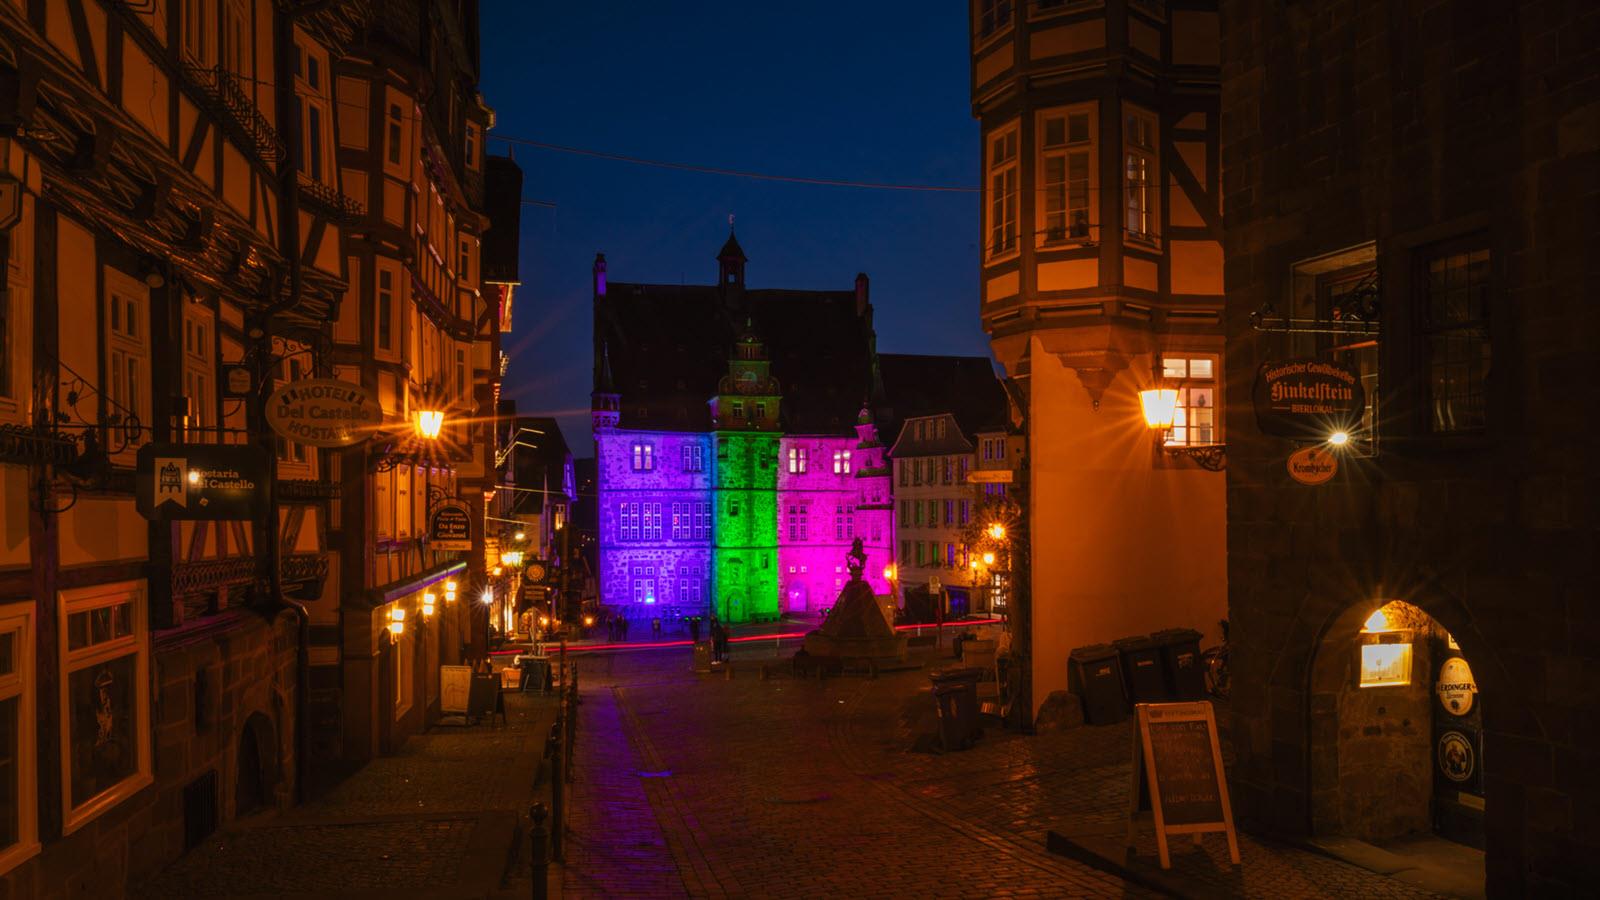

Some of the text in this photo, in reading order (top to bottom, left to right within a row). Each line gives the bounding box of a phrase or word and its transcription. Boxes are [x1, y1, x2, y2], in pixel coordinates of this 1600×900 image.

[1265, 364, 1306, 383] Historischer
[299, 386, 348, 402] HOTEL
[277, 405, 370, 419] Del Castello
[1291, 404, 1334, 413] BIERLOKAL
[190, 468, 240, 478] ostaria
[1293, 462, 1332, 476] Krombacher
[209, 479, 255, 489] Castello
[1440, 683, 1473, 691] ERDINGER
